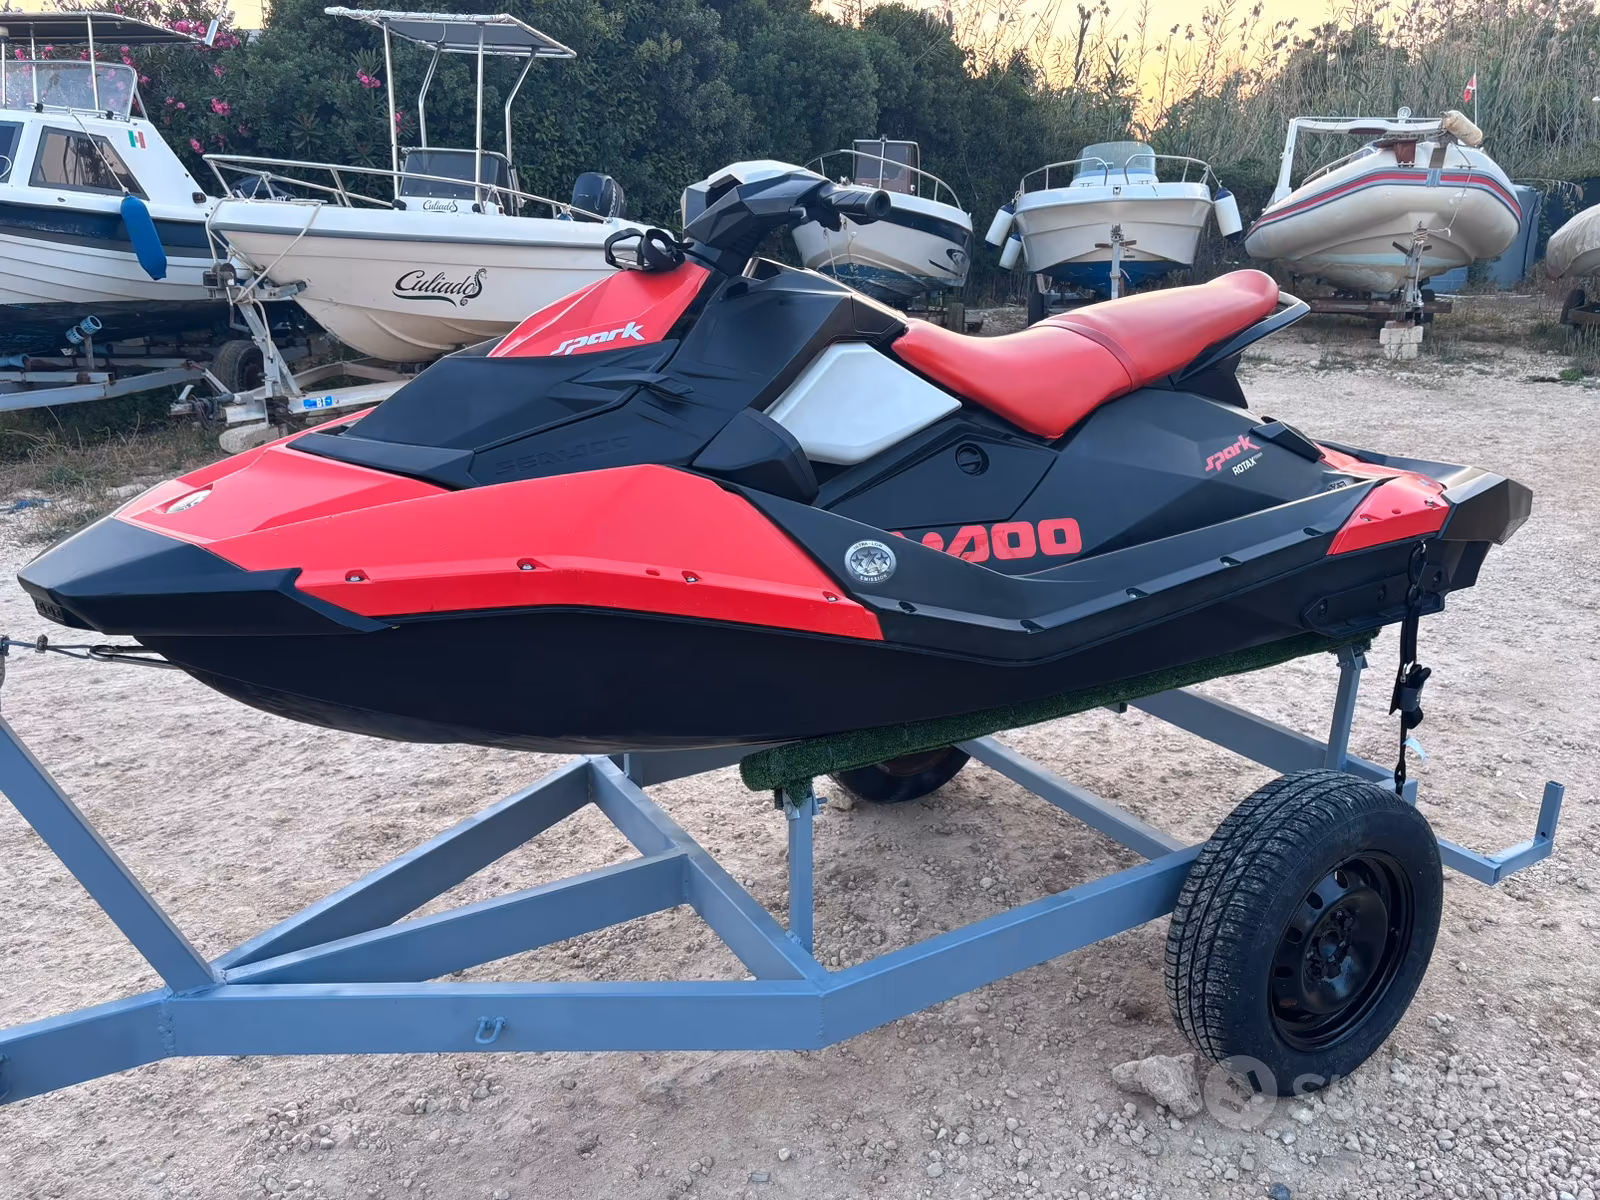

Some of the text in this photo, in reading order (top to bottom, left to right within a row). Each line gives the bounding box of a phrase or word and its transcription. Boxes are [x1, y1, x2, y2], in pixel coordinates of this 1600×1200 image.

[549, 321, 645, 356] spark
[1205, 434, 1261, 472] spark
[1231, 457, 1257, 476] ROTAX
